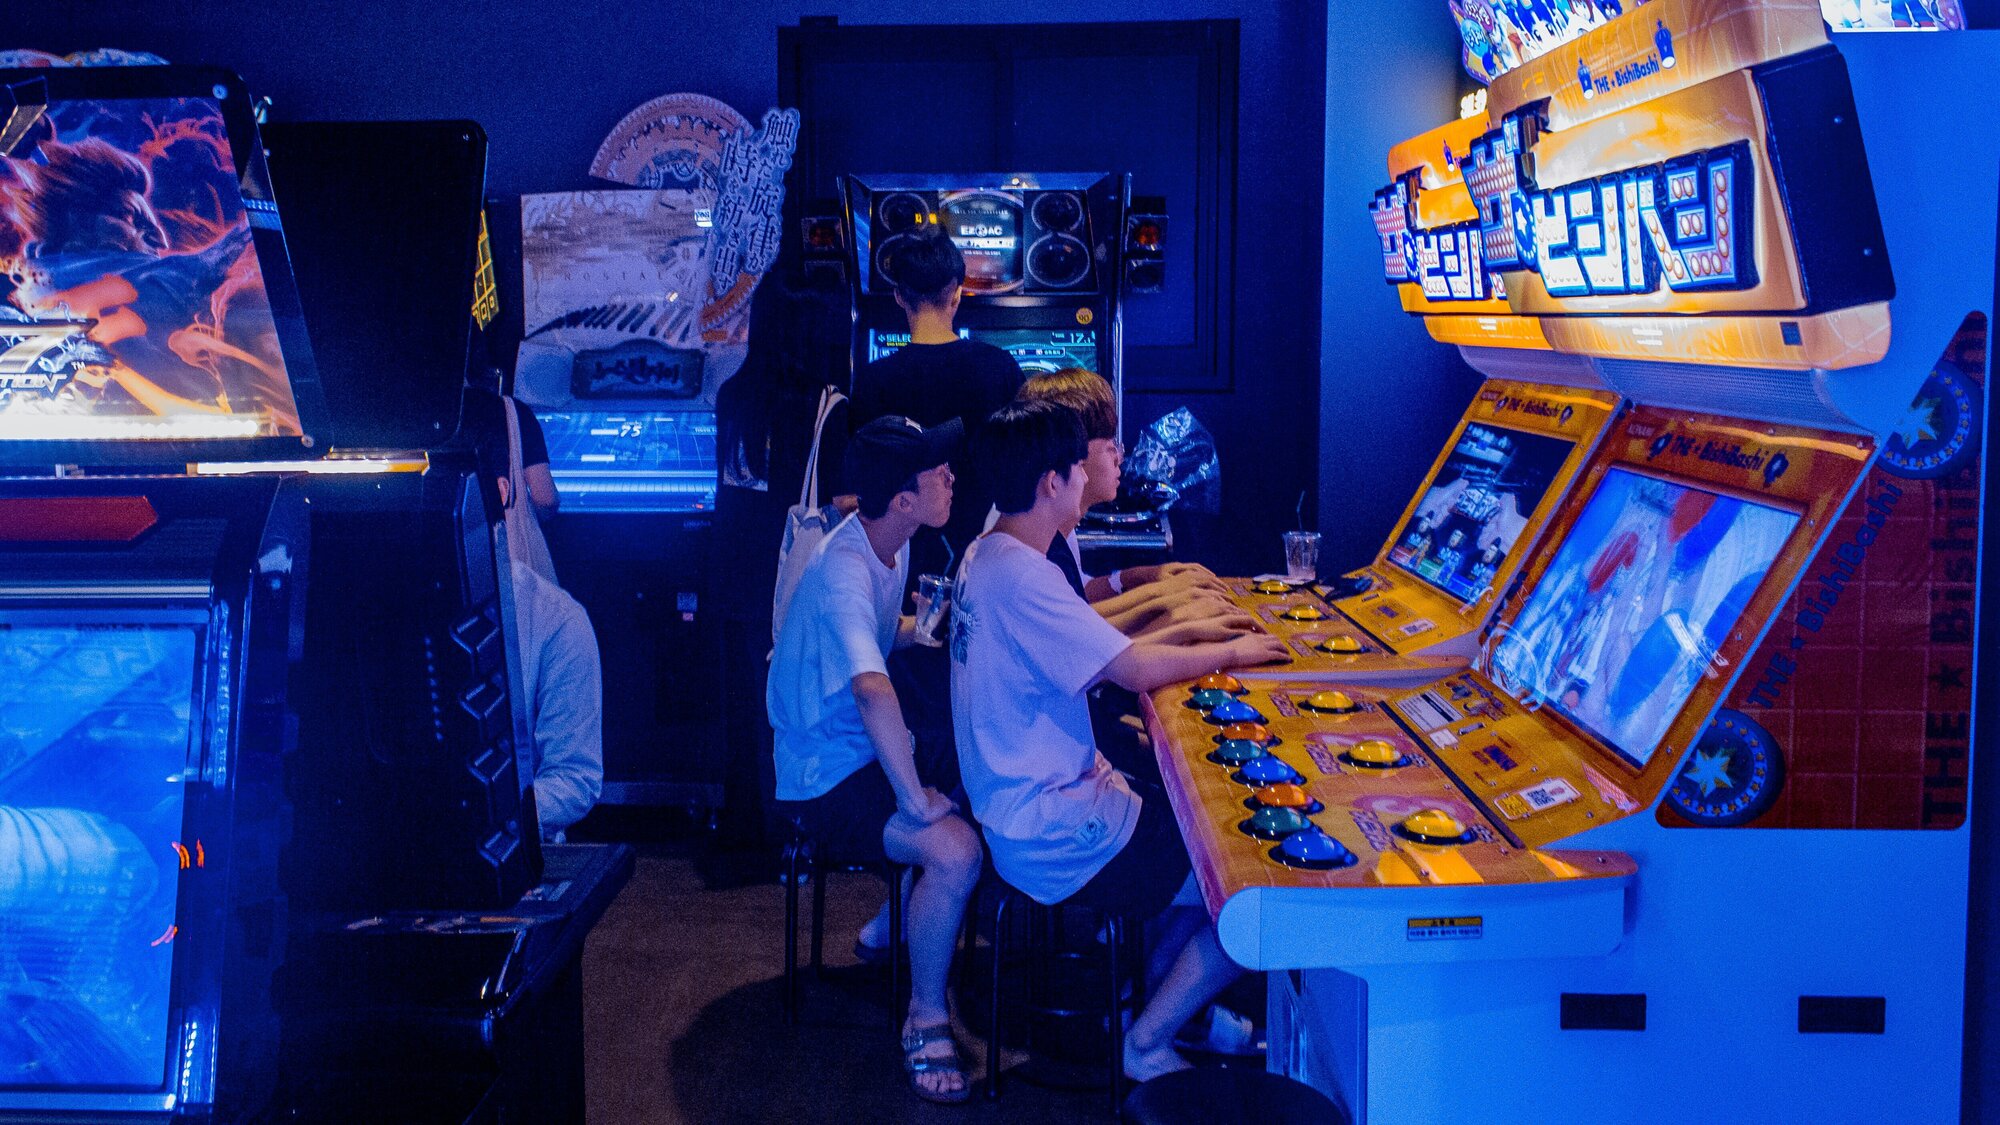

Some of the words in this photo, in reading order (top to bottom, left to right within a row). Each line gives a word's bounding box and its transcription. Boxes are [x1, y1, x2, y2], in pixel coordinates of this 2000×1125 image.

[1594, 75, 1610, 95] THE
[1615, 54, 1660, 88] BishiBashi
[563, 271, 698, 281] NOSTALGI
[71, 361, 86, 371] TM
[620, 424, 642, 438] 75
[1672, 434, 1696, 457] THE
[1699, 441, 1769, 471] BishiBashi
[1746, 652, 1797, 709] THE
[1796, 479, 1903, 633] BishiBashi
[1922, 713, 1967, 825] THE
